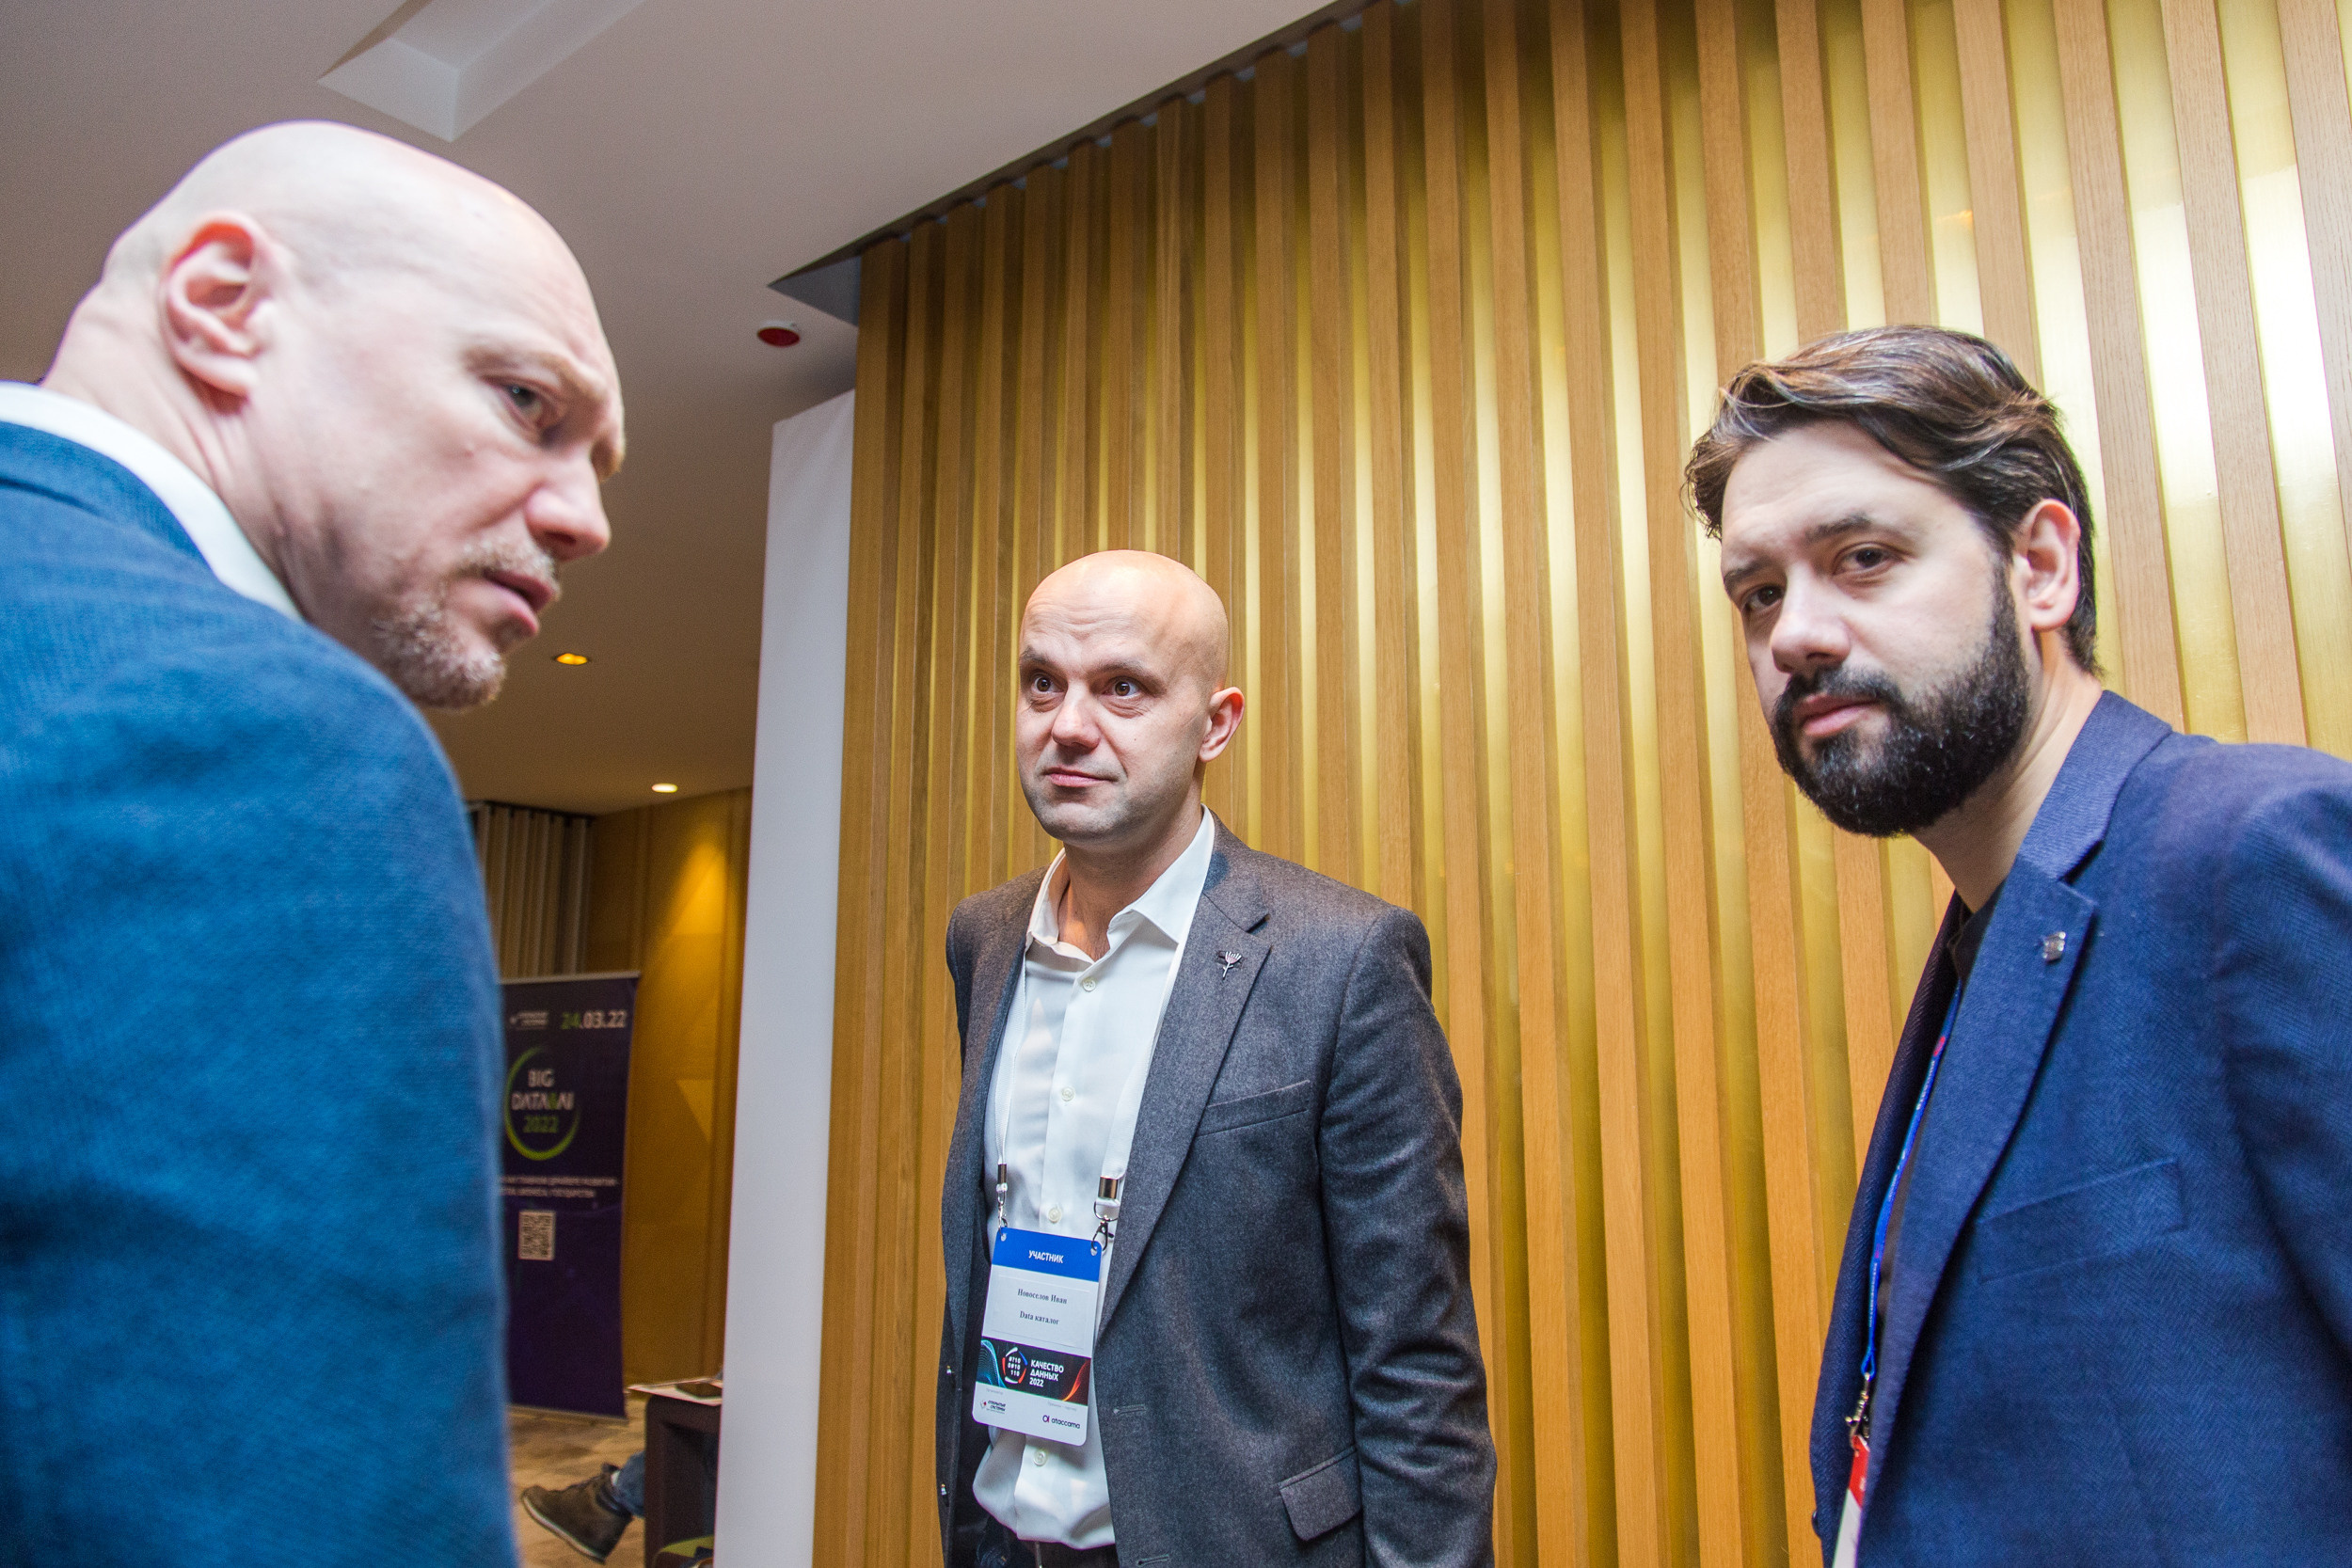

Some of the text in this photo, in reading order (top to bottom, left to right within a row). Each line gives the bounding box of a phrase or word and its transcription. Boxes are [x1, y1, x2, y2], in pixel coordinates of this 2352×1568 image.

[528, 1069, 554, 1087] BIG
[1028, 1249, 1064, 1263] УЧАСТНИК
[1017, 1288, 1067, 1304] Новоселов Иван
[1020, 1310, 1059, 1324] Data каталог
[1030, 1359, 1064, 1373] КАЧЕСТВО
[1029, 1377, 1044, 1387] 2022
[1030, 1369, 1058, 1382] ДАННЫХ
[1051, 1418, 1080, 1429] ataccama
